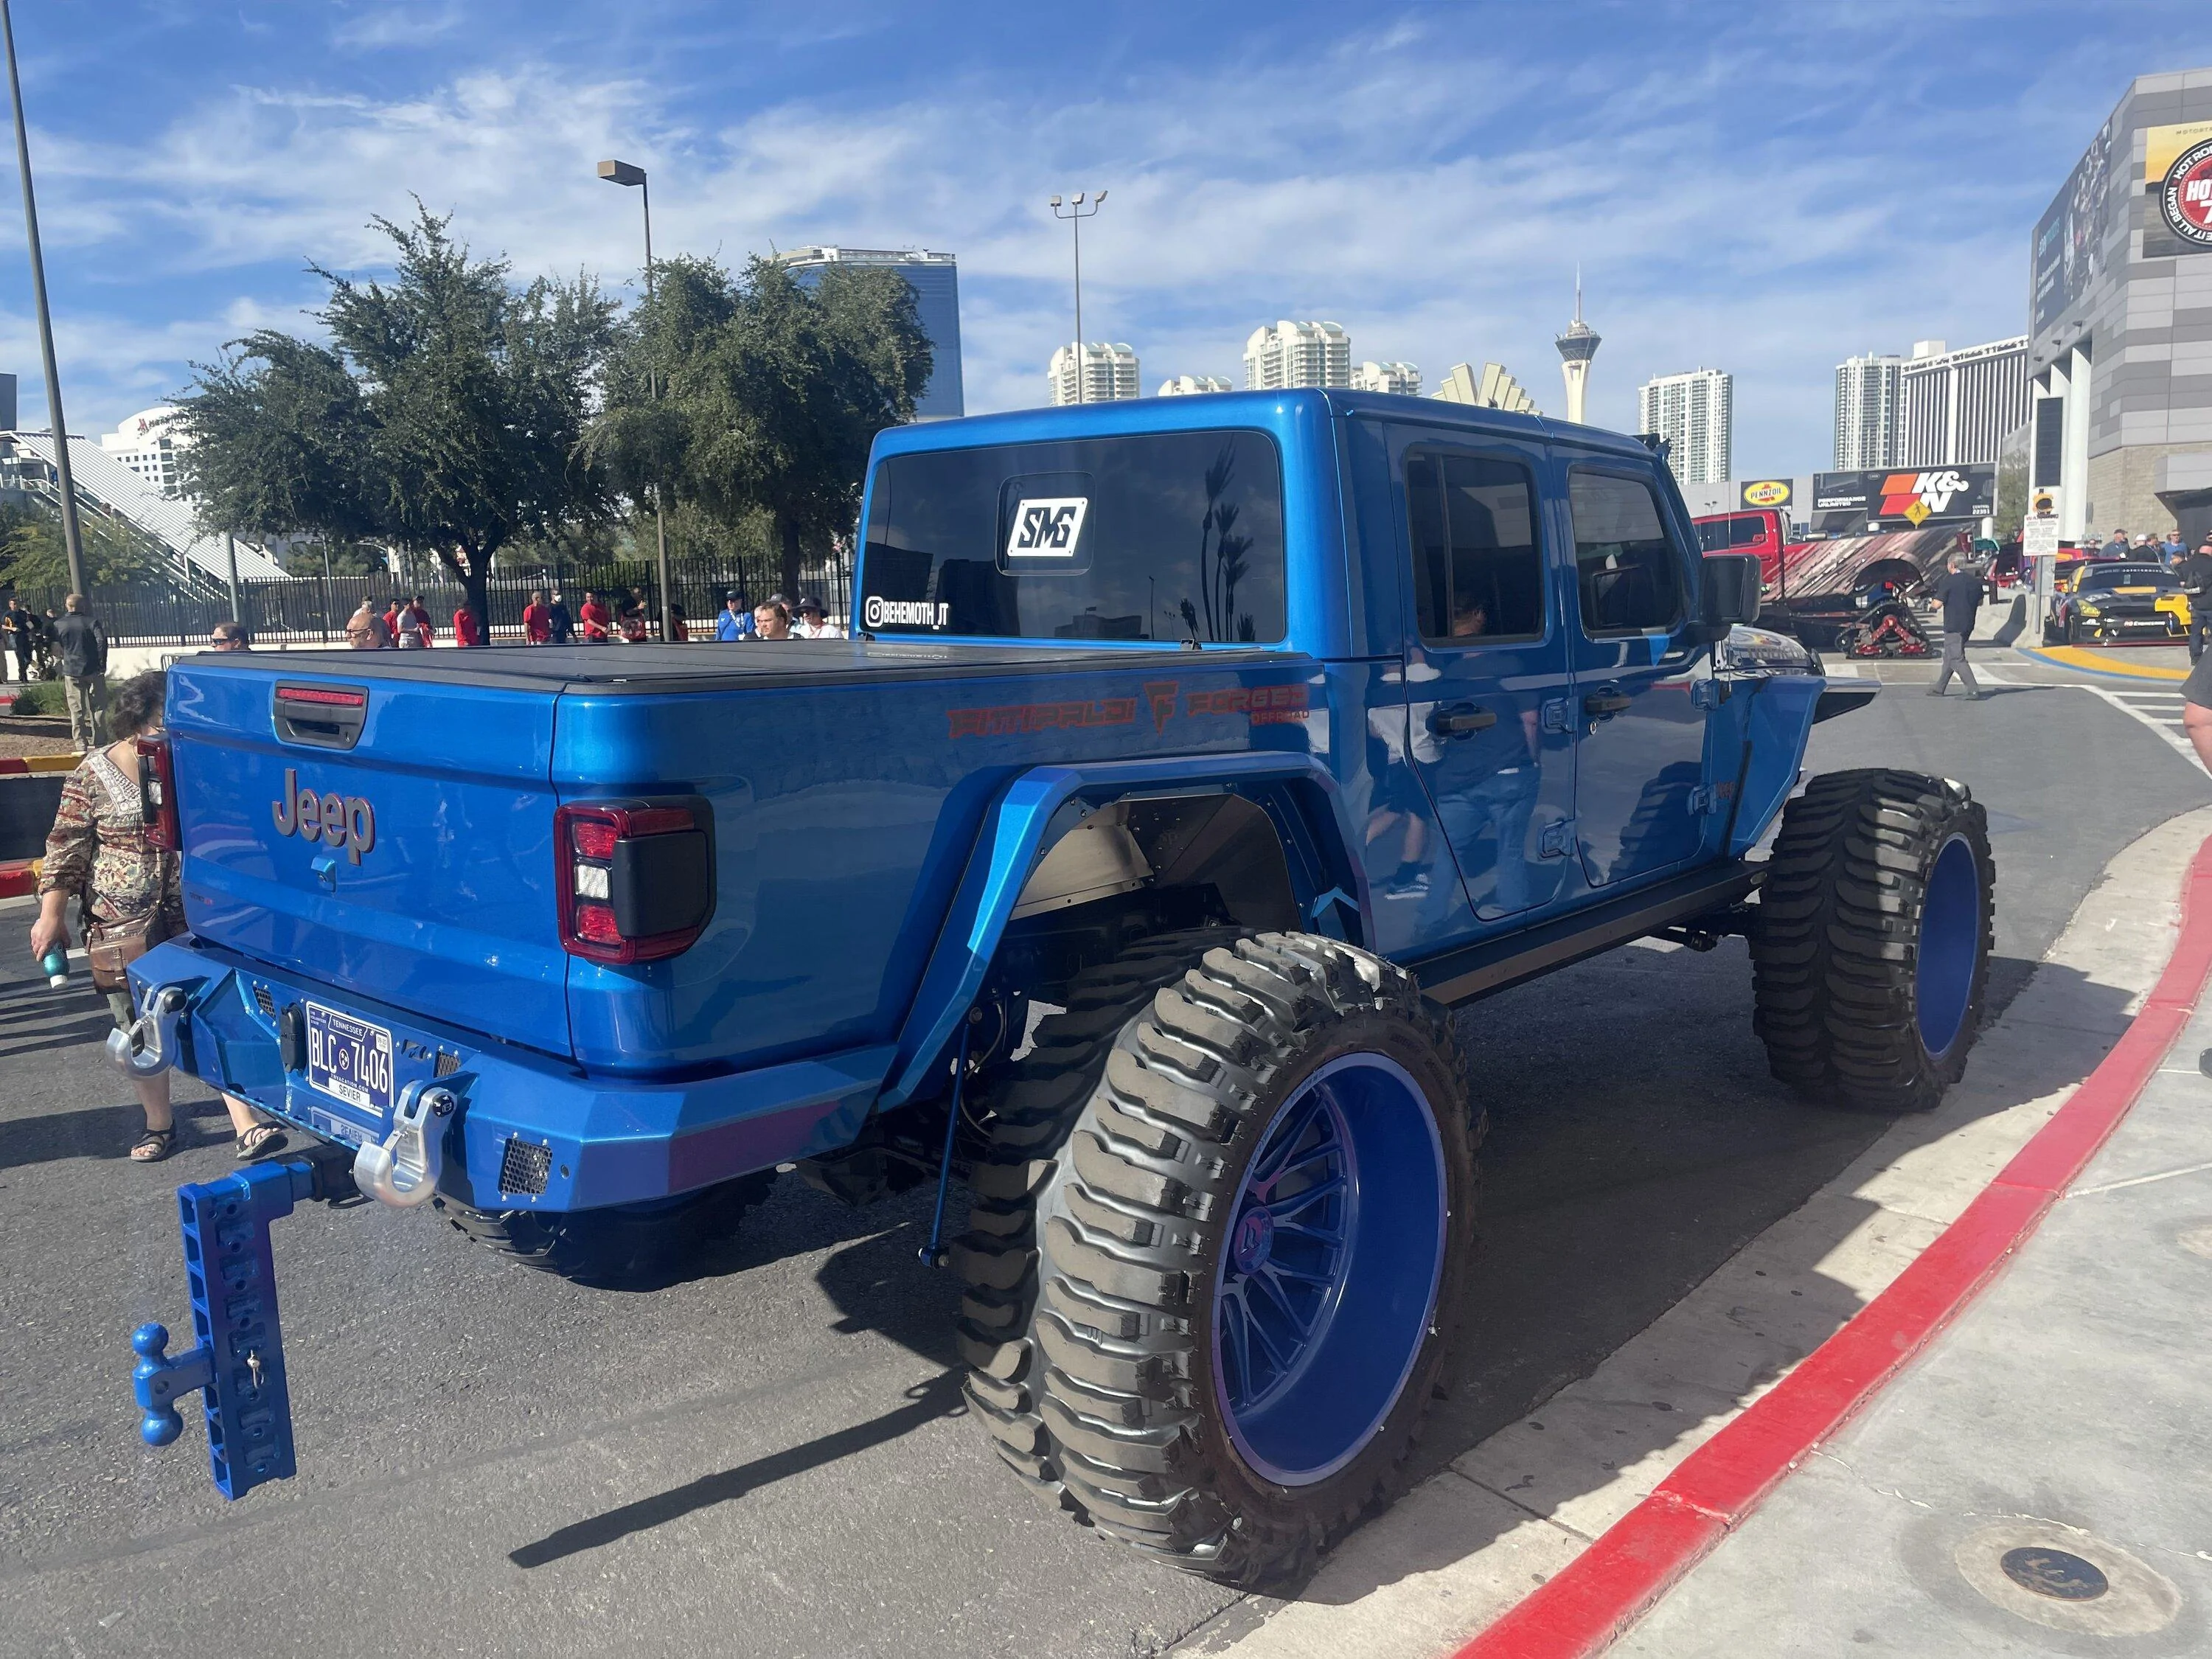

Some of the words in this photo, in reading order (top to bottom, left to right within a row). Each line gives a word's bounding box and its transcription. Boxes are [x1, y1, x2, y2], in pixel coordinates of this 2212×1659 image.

[2173, 157, 2194, 179] HOT
[2166, 187, 2183, 223] BEGAN
[2178, 218, 2197, 235] ALL
[1750, 487, 1783, 498] PENNZOIL
[1016, 505, 1078, 549] SMG
[946, 697, 1138, 740] FITTIPALDI
[1186, 684, 1310, 716] FORGED
[1249, 709, 1311, 726] OFFROAD
[271, 768, 375, 867] Jeep
[332, 1018, 364, 1037] TENNESSEE
[310, 1027, 337, 1074] BLC
[350, 1040, 389, 1094] 7406
[338, 1084, 361, 1103] SEVIER
